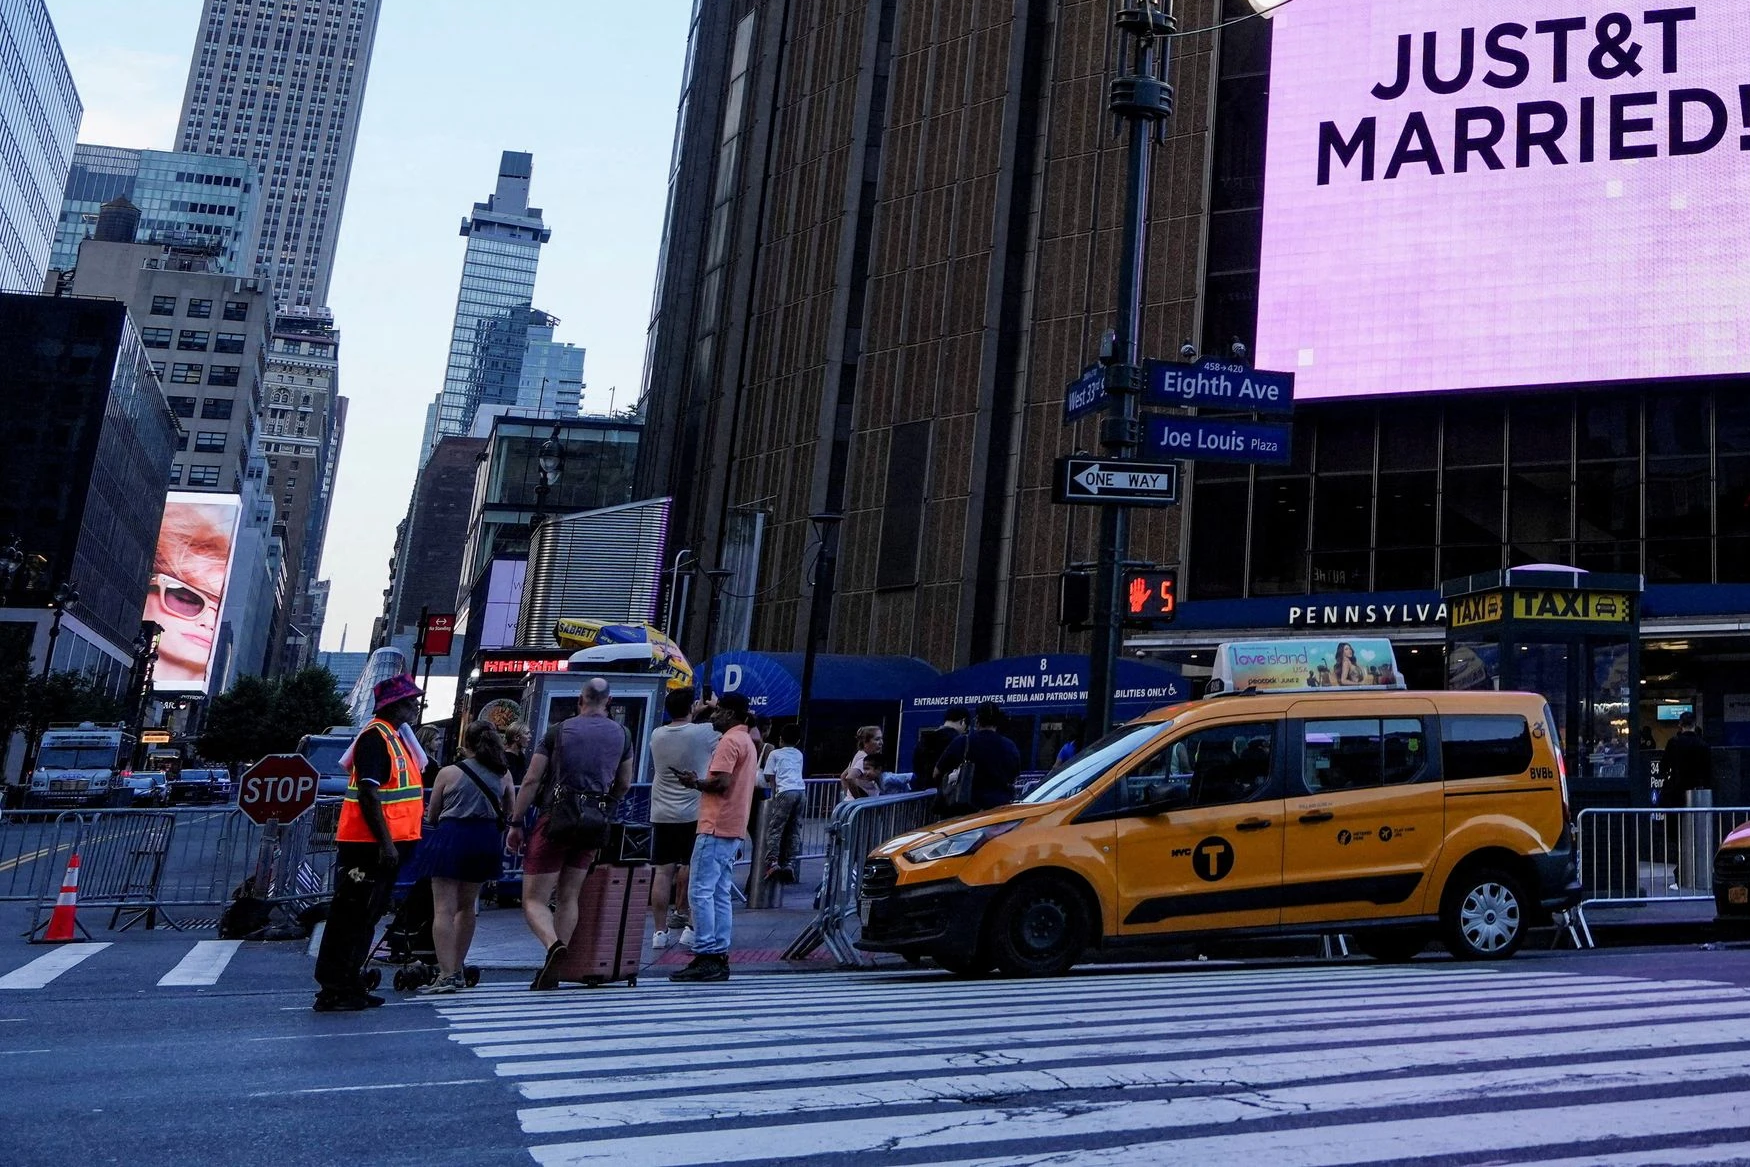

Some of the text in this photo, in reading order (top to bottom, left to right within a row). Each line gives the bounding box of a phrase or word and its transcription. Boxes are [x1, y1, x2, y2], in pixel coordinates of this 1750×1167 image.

[1370, 6, 1696, 101] JUST&T
[1203, 361, 1244, 373] 458 420
[1164, 370, 1280, 401] Eighth Ave
[1068, 388, 1086, 412] West
[1159, 425, 1278, 452] Joe Louis Plaza
[1085, 472, 1161, 489] ONE WAY
[1161, 580, 1173, 612] 5
[1519, 591, 1590, 618] TAXI
[1454, 595, 1487, 624] TAXI
[1040, 658, 1047, 671] 8
[1233, 645, 1308, 666] love island
[723, 664, 743, 693] D
[1005, 673, 1080, 689] PENN PLAZA
[1248, 676, 1277, 685] peacock
[913, 696, 949, 706] ENTRANCE
[949, 696, 964, 705] FOR
[1006, 693, 1029, 703] MEDIA
[1029, 692, 1045, 702] AND
[1045, 691, 1079, 701] PATRONS
[1146, 687, 1168, 698] ONLY
[1650, 762, 1660, 775] 34
[243, 776, 314, 804] STOP
[1171, 848, 1192, 858] NYC
[1201, 844, 1225, 876] T
